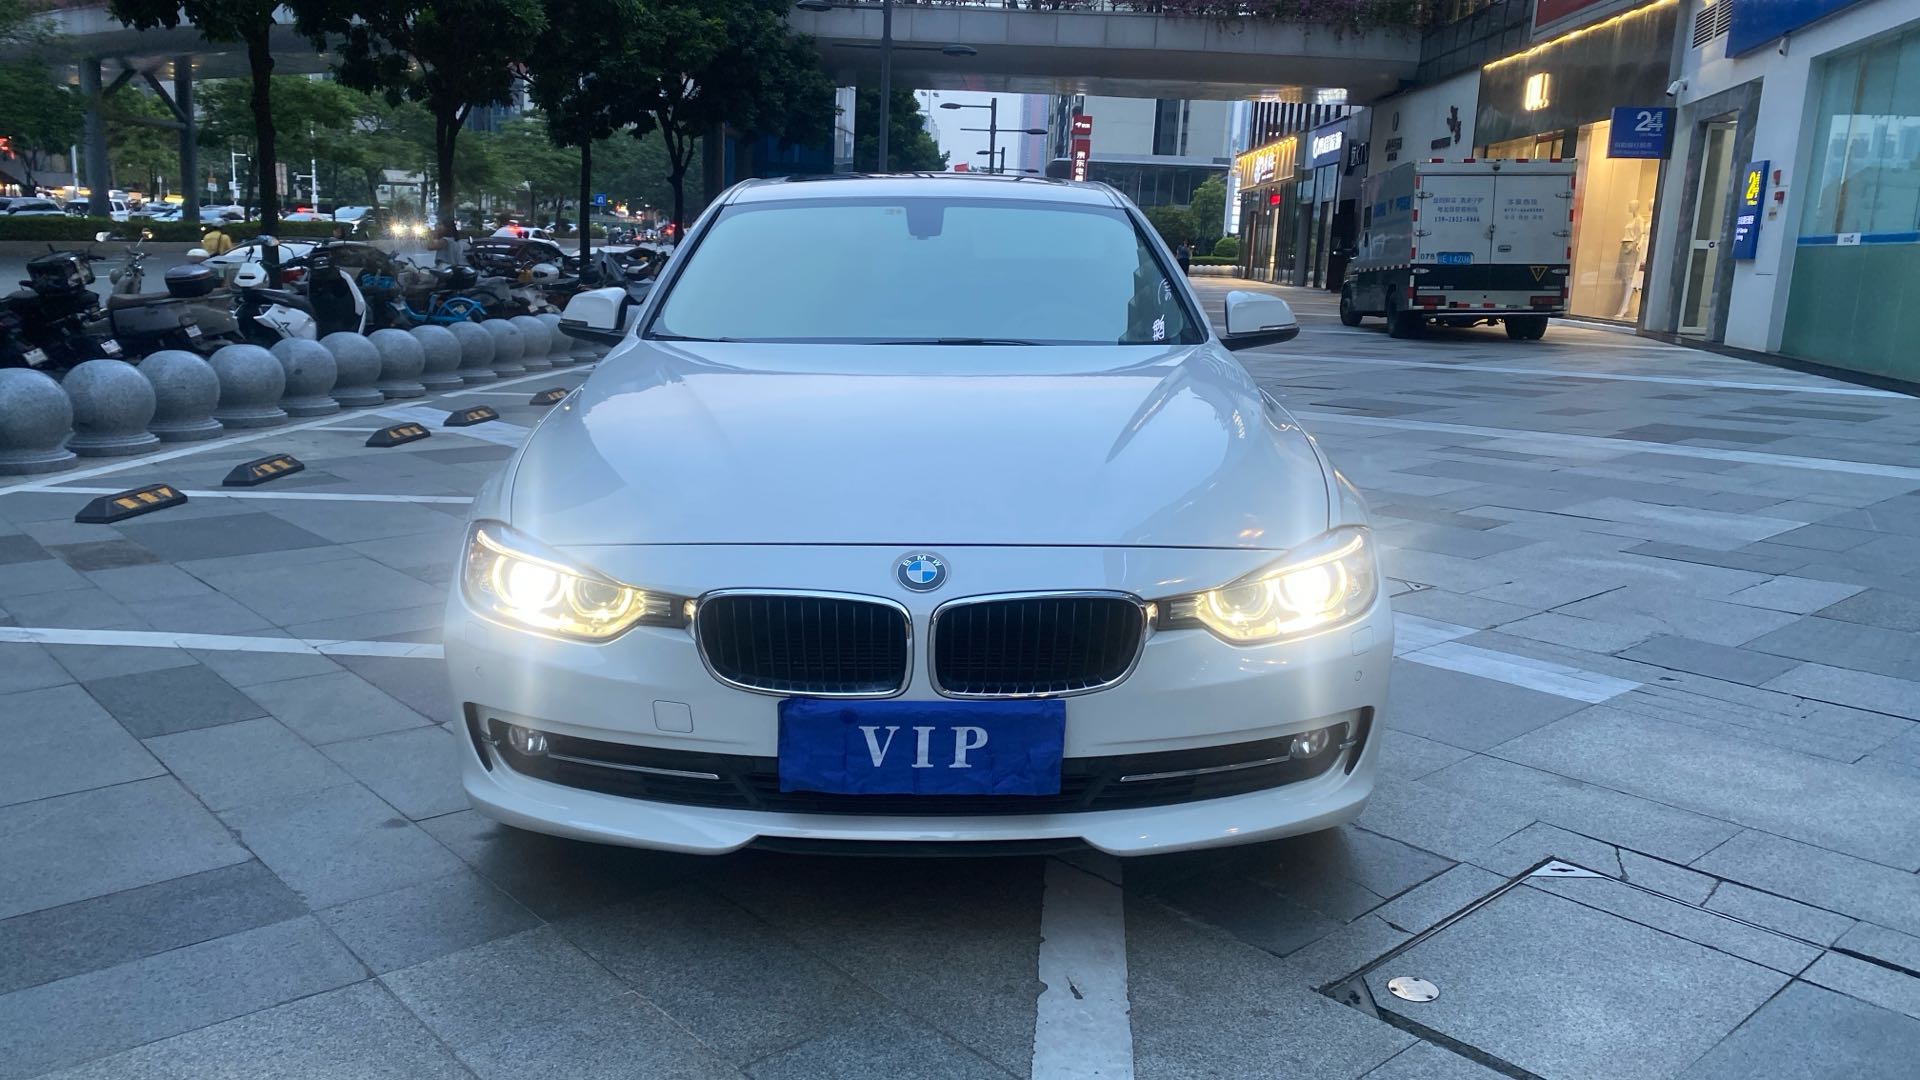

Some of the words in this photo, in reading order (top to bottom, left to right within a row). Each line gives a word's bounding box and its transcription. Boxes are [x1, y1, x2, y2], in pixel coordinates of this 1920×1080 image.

[1635, 111, 1663, 131] 24
[902, 555, 942, 567] BMW
[858, 726, 989, 768] VIP
